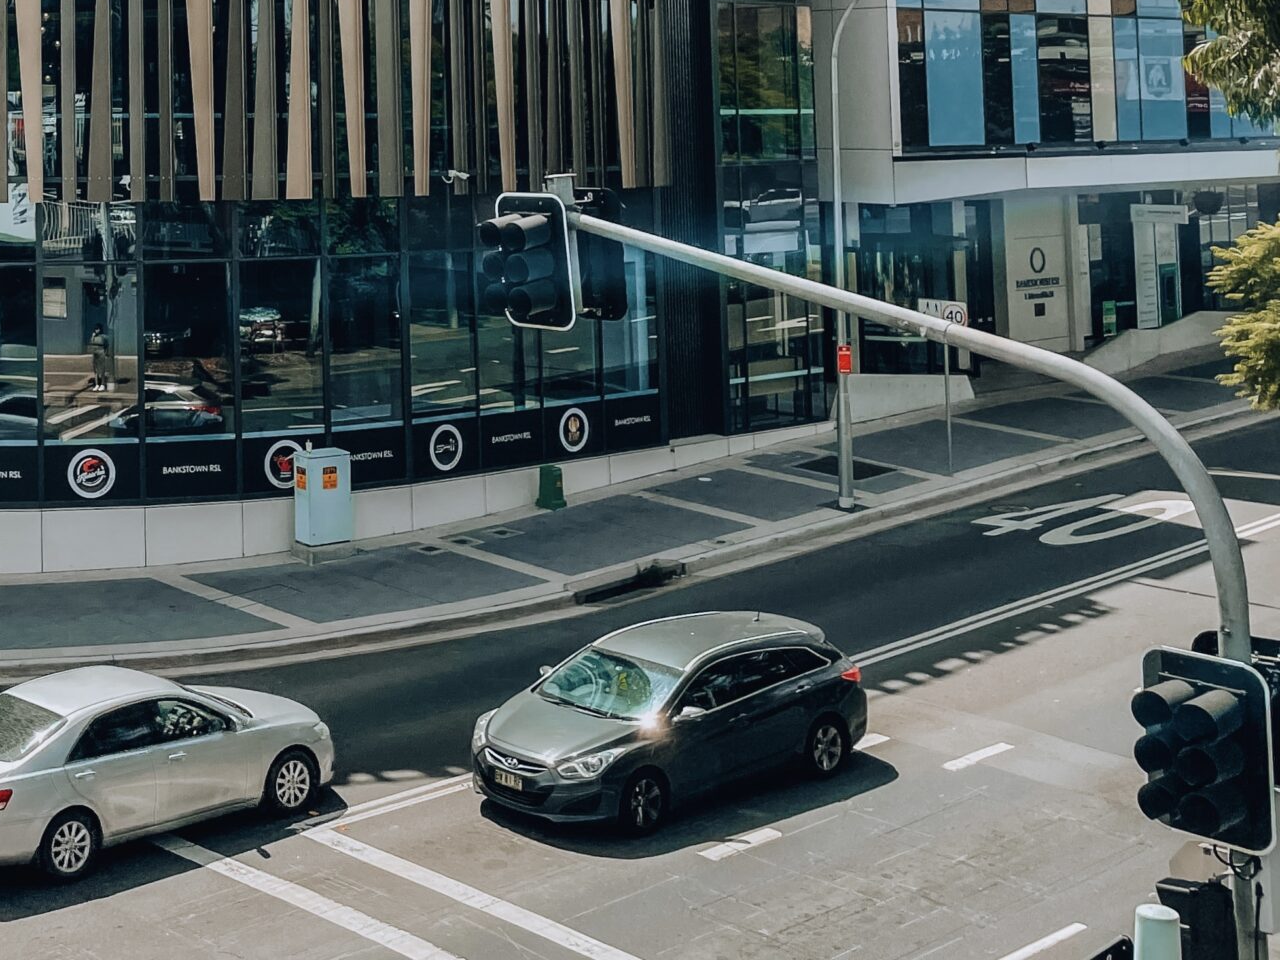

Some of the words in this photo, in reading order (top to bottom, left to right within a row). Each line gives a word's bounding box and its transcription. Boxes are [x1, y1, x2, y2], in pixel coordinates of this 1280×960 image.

[946, 310, 963, 324] 40
[348, 451, 383, 461] ANKSTOWN
[8, 470, 22, 479] RSL
[162, 465, 208, 475] BANKSTOWN
[209, 464, 222, 472] RSL
[971, 493, 1197, 546] 40
